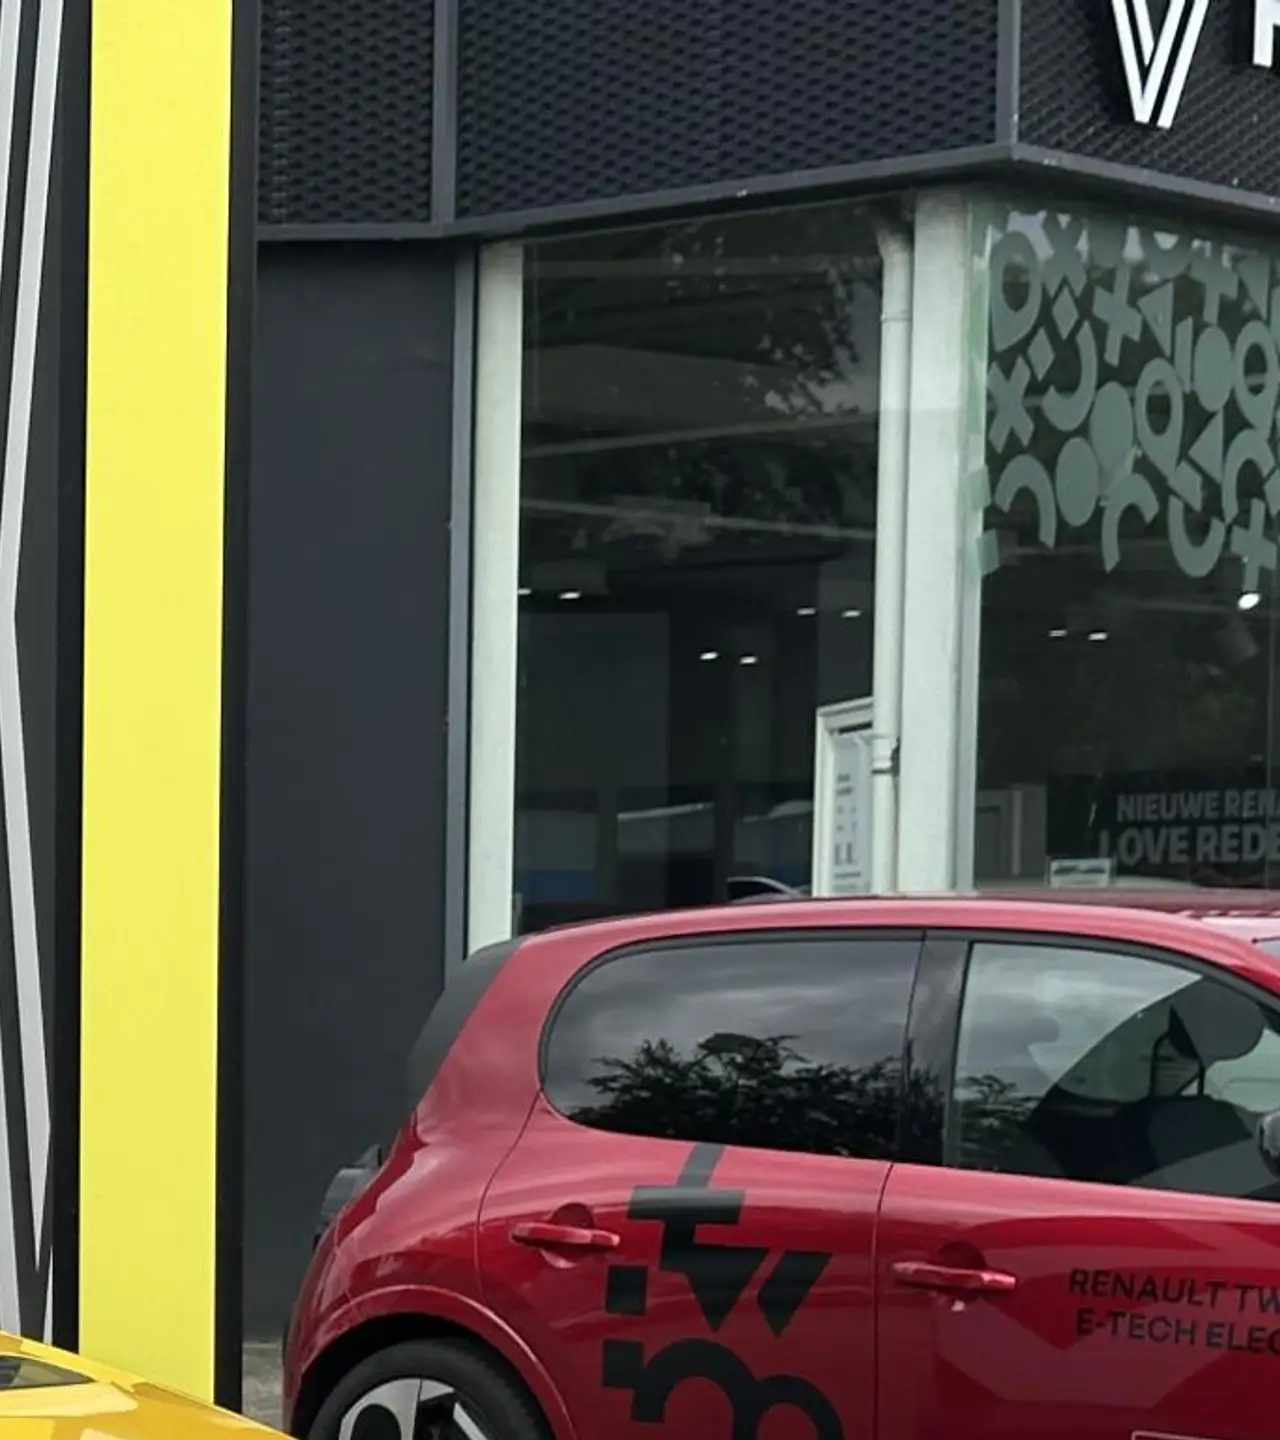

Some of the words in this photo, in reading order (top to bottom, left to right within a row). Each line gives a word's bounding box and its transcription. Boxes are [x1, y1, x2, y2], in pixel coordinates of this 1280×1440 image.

[1117, 791, 1220, 823] NIEUWE
[1224, 788, 1280, 819] REN
[1100, 826, 1190, 867] LOVE
[1069, 1268, 1228, 1309] RENAULT
[1076, 1308, 1197, 1346] E-TECH
